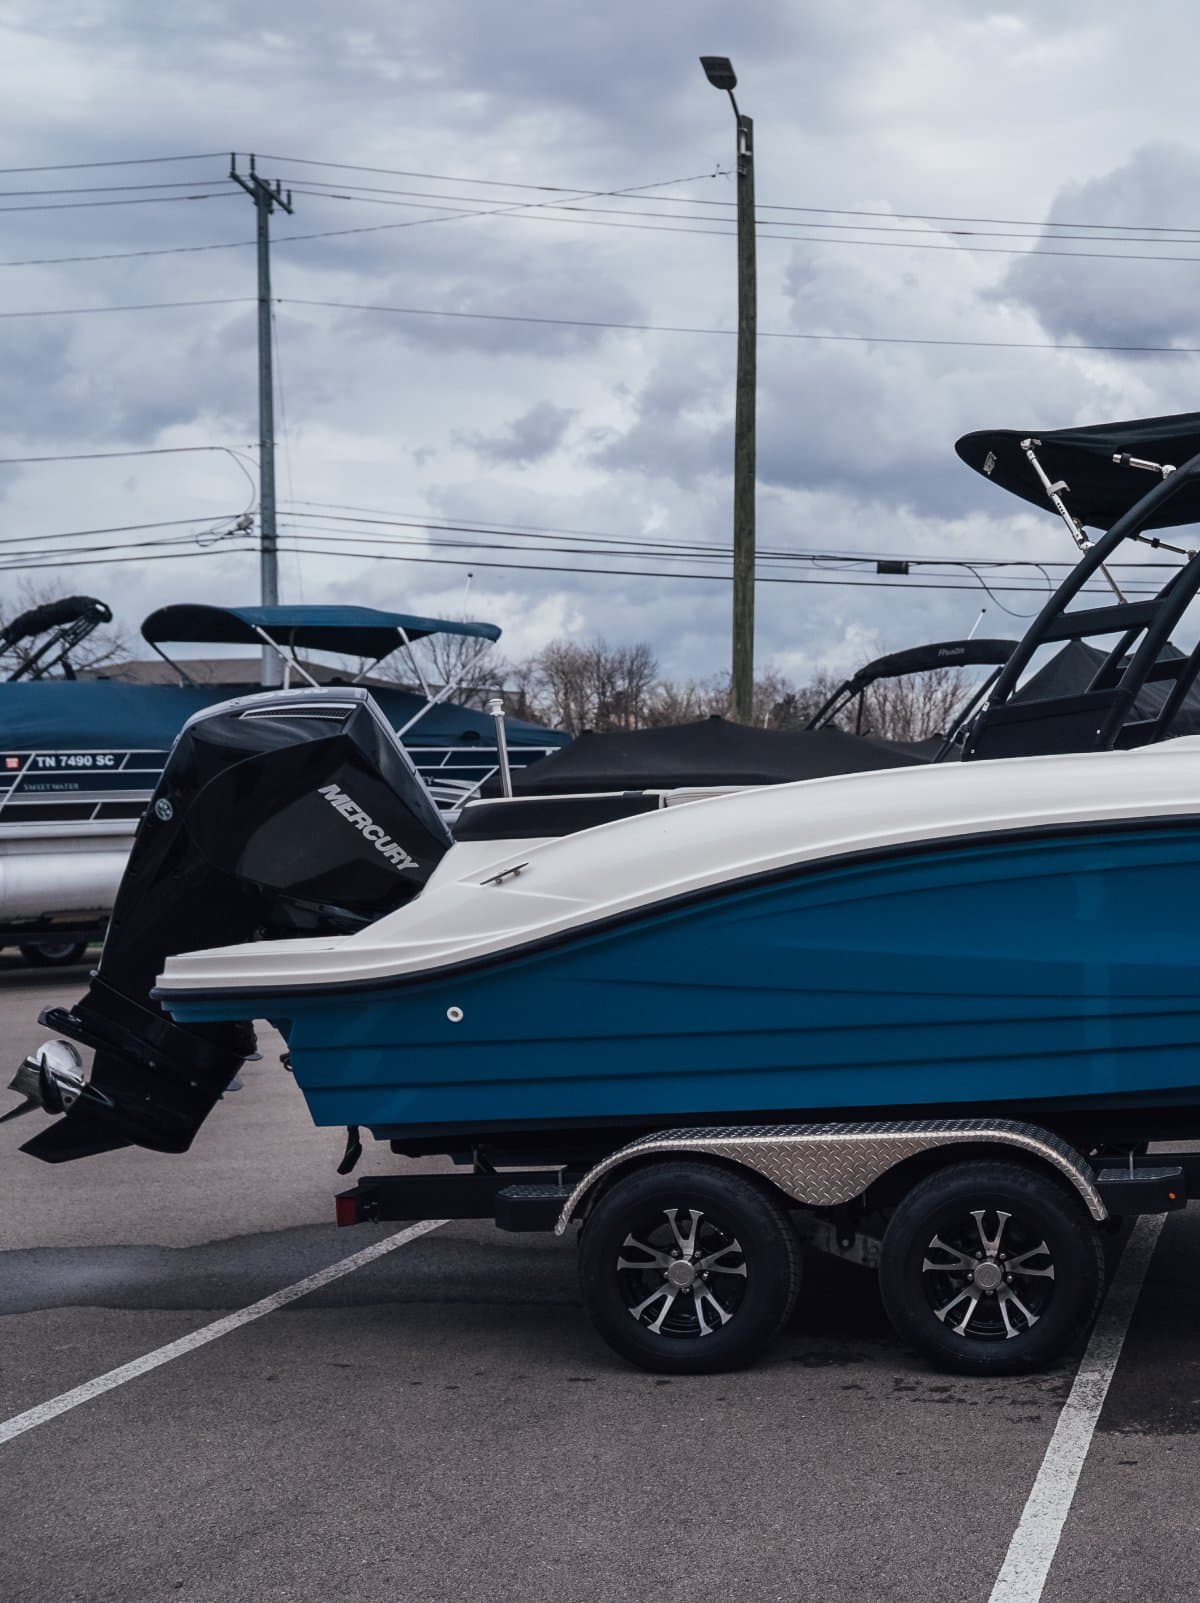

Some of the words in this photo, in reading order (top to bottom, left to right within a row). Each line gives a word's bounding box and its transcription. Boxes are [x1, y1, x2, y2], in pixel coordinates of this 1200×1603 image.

[36, 756, 56, 768] TN
[59, 755, 92, 767] 7490
[95, 755, 115, 766] SC
[318, 784, 419, 870] MERCURY
